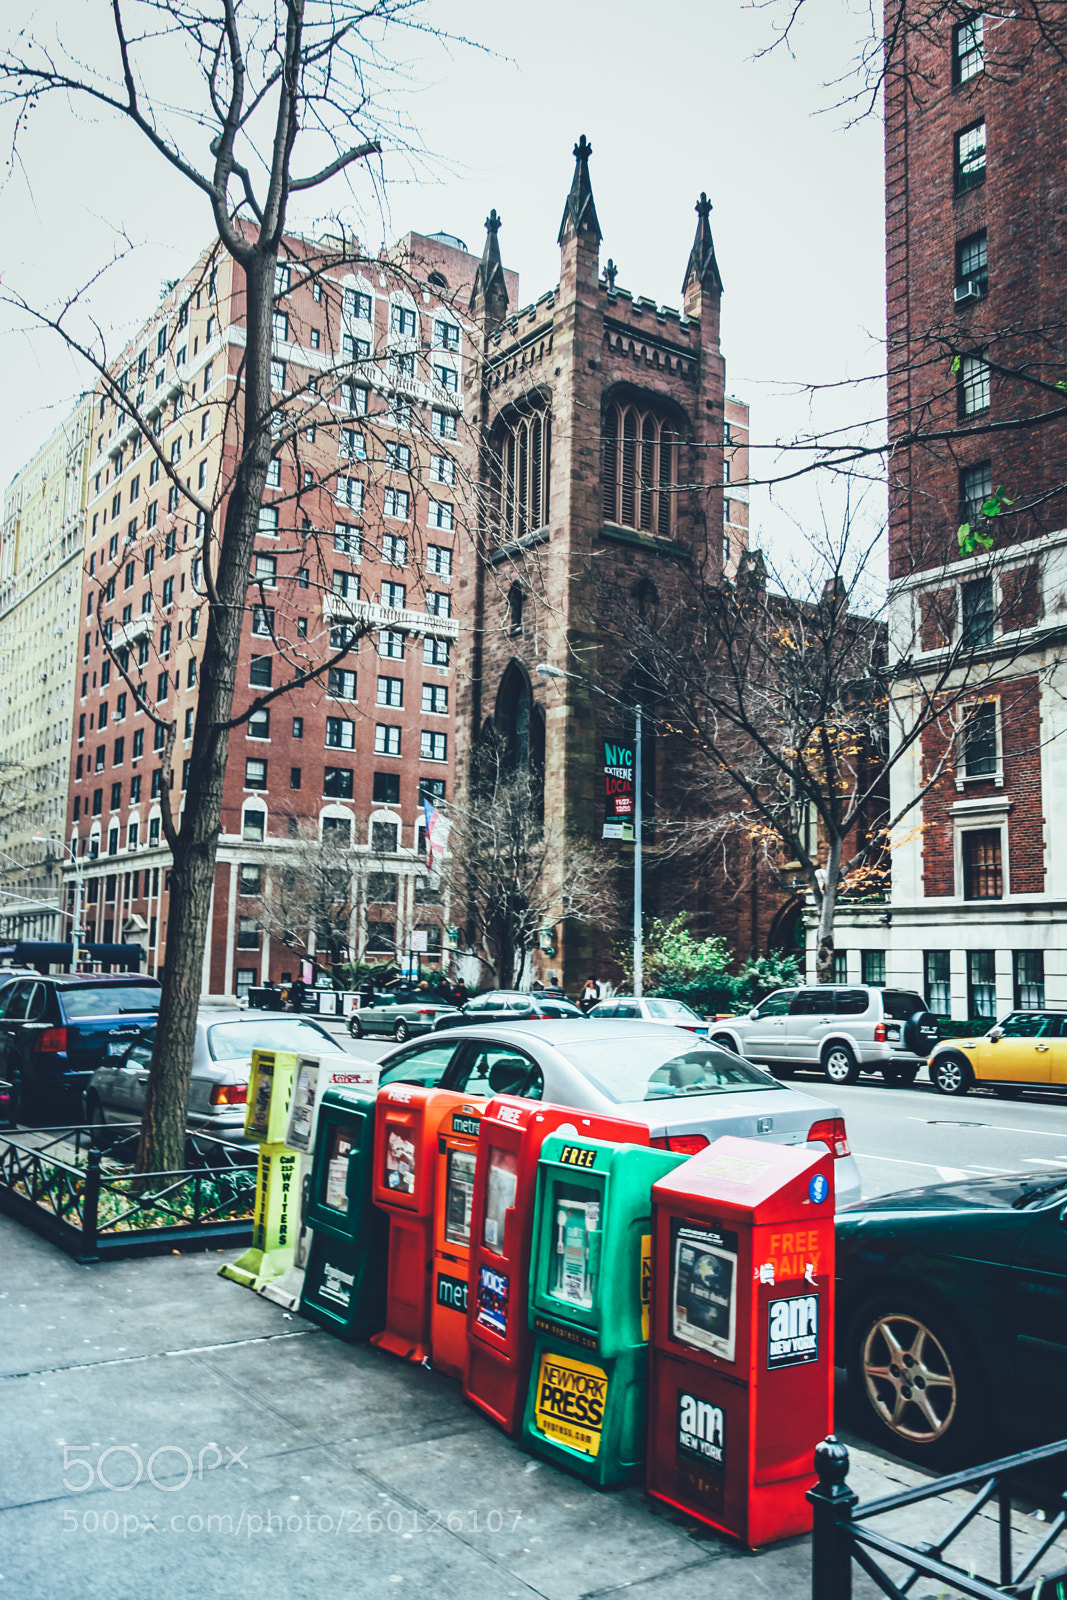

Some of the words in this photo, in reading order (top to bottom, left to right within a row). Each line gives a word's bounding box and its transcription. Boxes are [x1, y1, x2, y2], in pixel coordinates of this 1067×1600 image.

[604, 743, 632, 766] NYC
[604, 767, 632, 781] EXTREME
[388, 1090, 411, 1104] FREE
[497, 1105, 522, 1124] FREE
[561, 1147, 595, 1167] FREE
[279, 1173, 292, 1245] WRITERS
[770, 1230, 818, 1255] FREE
[766, 1251, 821, 1277] DAILY
[482, 1269, 504, 1296] VOICE
[770, 1297, 817, 1341] am
[770, 1339, 792, 1356] NEW
[792, 1335, 817, 1351] YORK
[540, 1383, 604, 1425] PRESS
[680, 1394, 723, 1447] am
[680, 1430, 698, 1450] NEW
[700, 1440, 723, 1461] YORK
